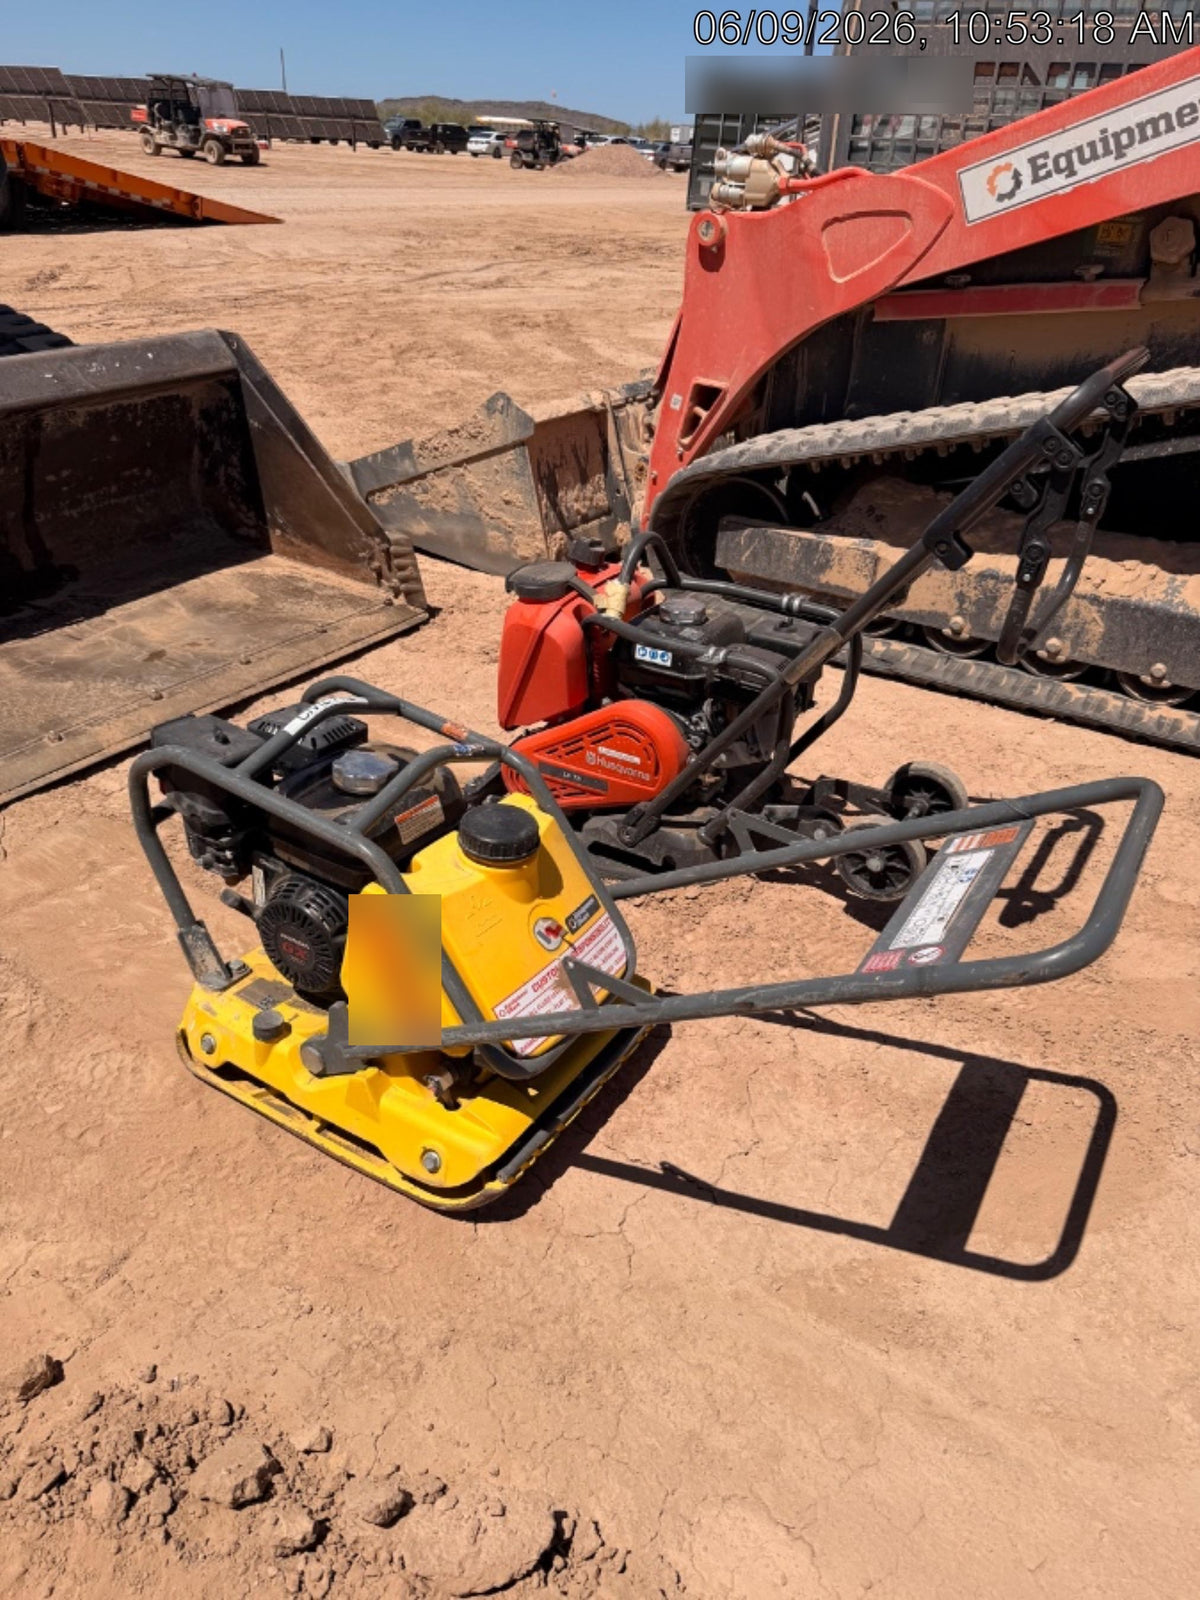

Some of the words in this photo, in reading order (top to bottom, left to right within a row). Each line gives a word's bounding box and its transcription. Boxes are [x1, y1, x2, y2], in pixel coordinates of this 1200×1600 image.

[1027, 98, 1200, 185] Equipme
[597, 755, 650, 781] Husqvarna
[531, 966, 560, 992] CUSTO
